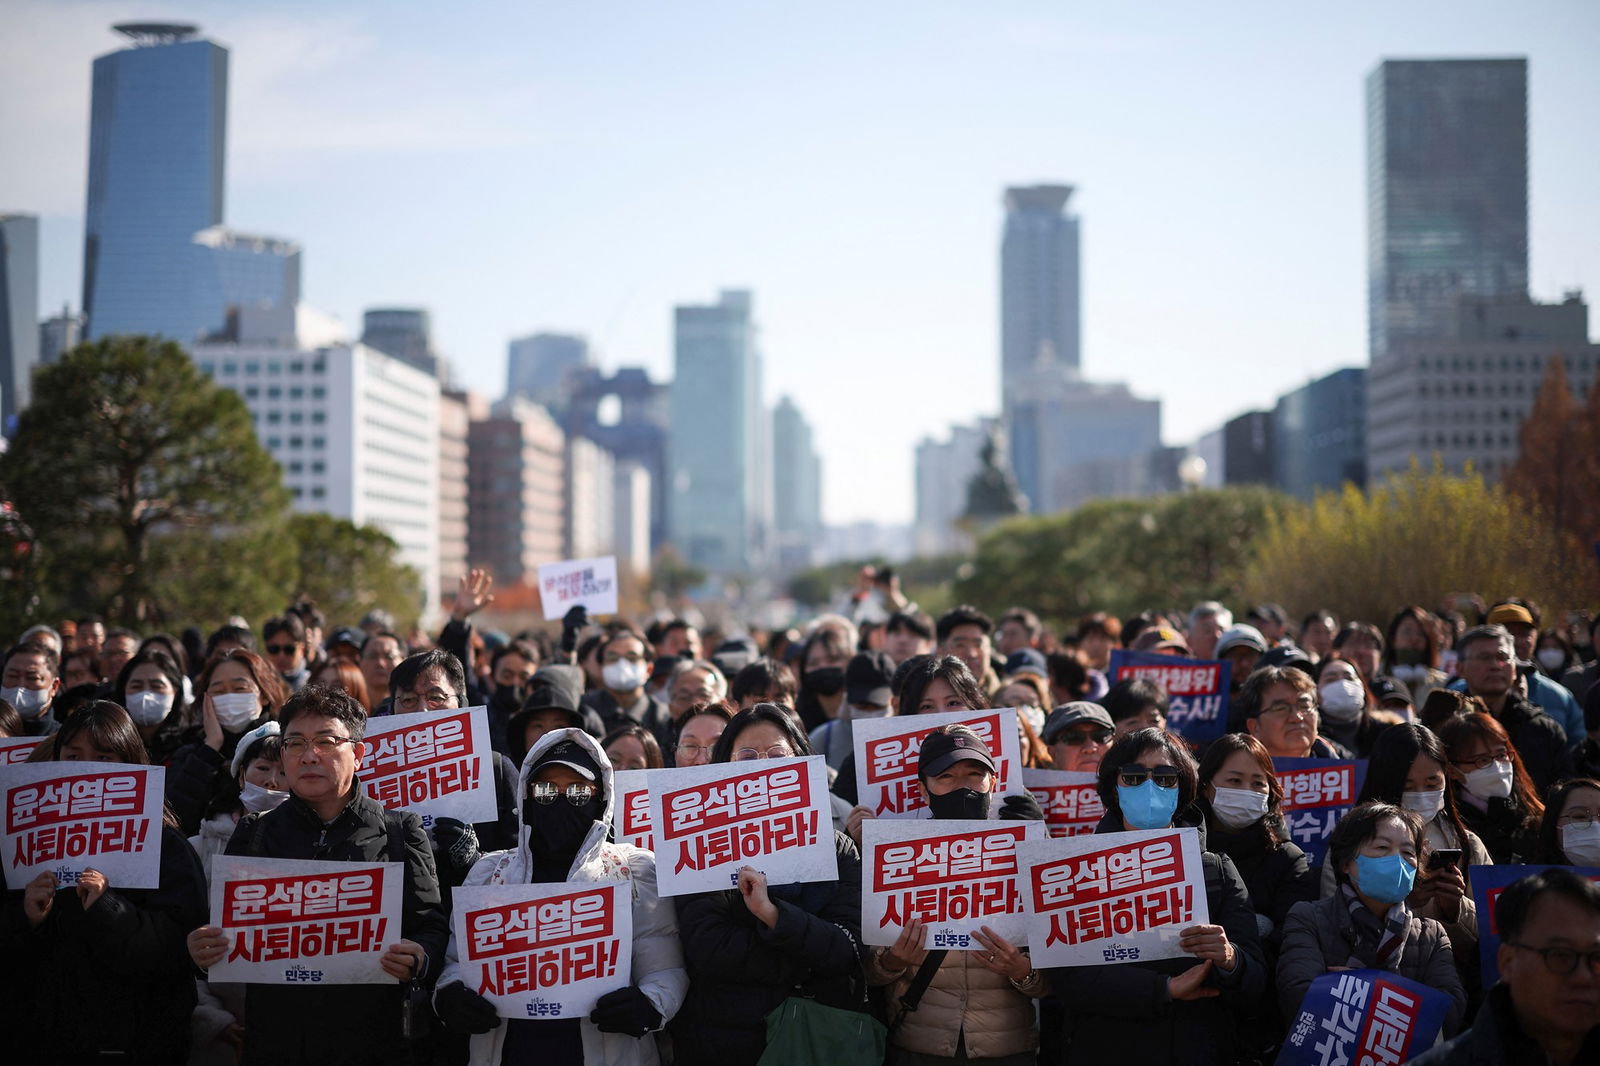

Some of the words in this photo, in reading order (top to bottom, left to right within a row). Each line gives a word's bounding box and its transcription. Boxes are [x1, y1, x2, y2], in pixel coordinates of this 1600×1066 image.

[12, 776, 137, 827] 윤석열은
[671, 769, 801, 832] 윤석열은
[13, 819, 149, 869] 사퇴하라!
[674, 810, 819, 876] 사퇴하라!
[882, 833, 1016, 885] 윤석열은
[231, 874, 373, 921] 윤석열은
[1040, 842, 1175, 905] 윤석열은
[228, 917, 387, 964] 사퇴하라!
[474, 894, 605, 953] 윤석열은
[934, 934, 970, 947] 민주당
[1046, 885, 1193, 948] 사퇴하라!
[285, 970, 323, 982] 민주당
[479, 939, 620, 996] 사퇴하라!
[1103, 947, 1140, 962] 민주당
[526, 1003, 562, 1016] 민주당
[1291, 1011, 1315, 1047] 민주당
